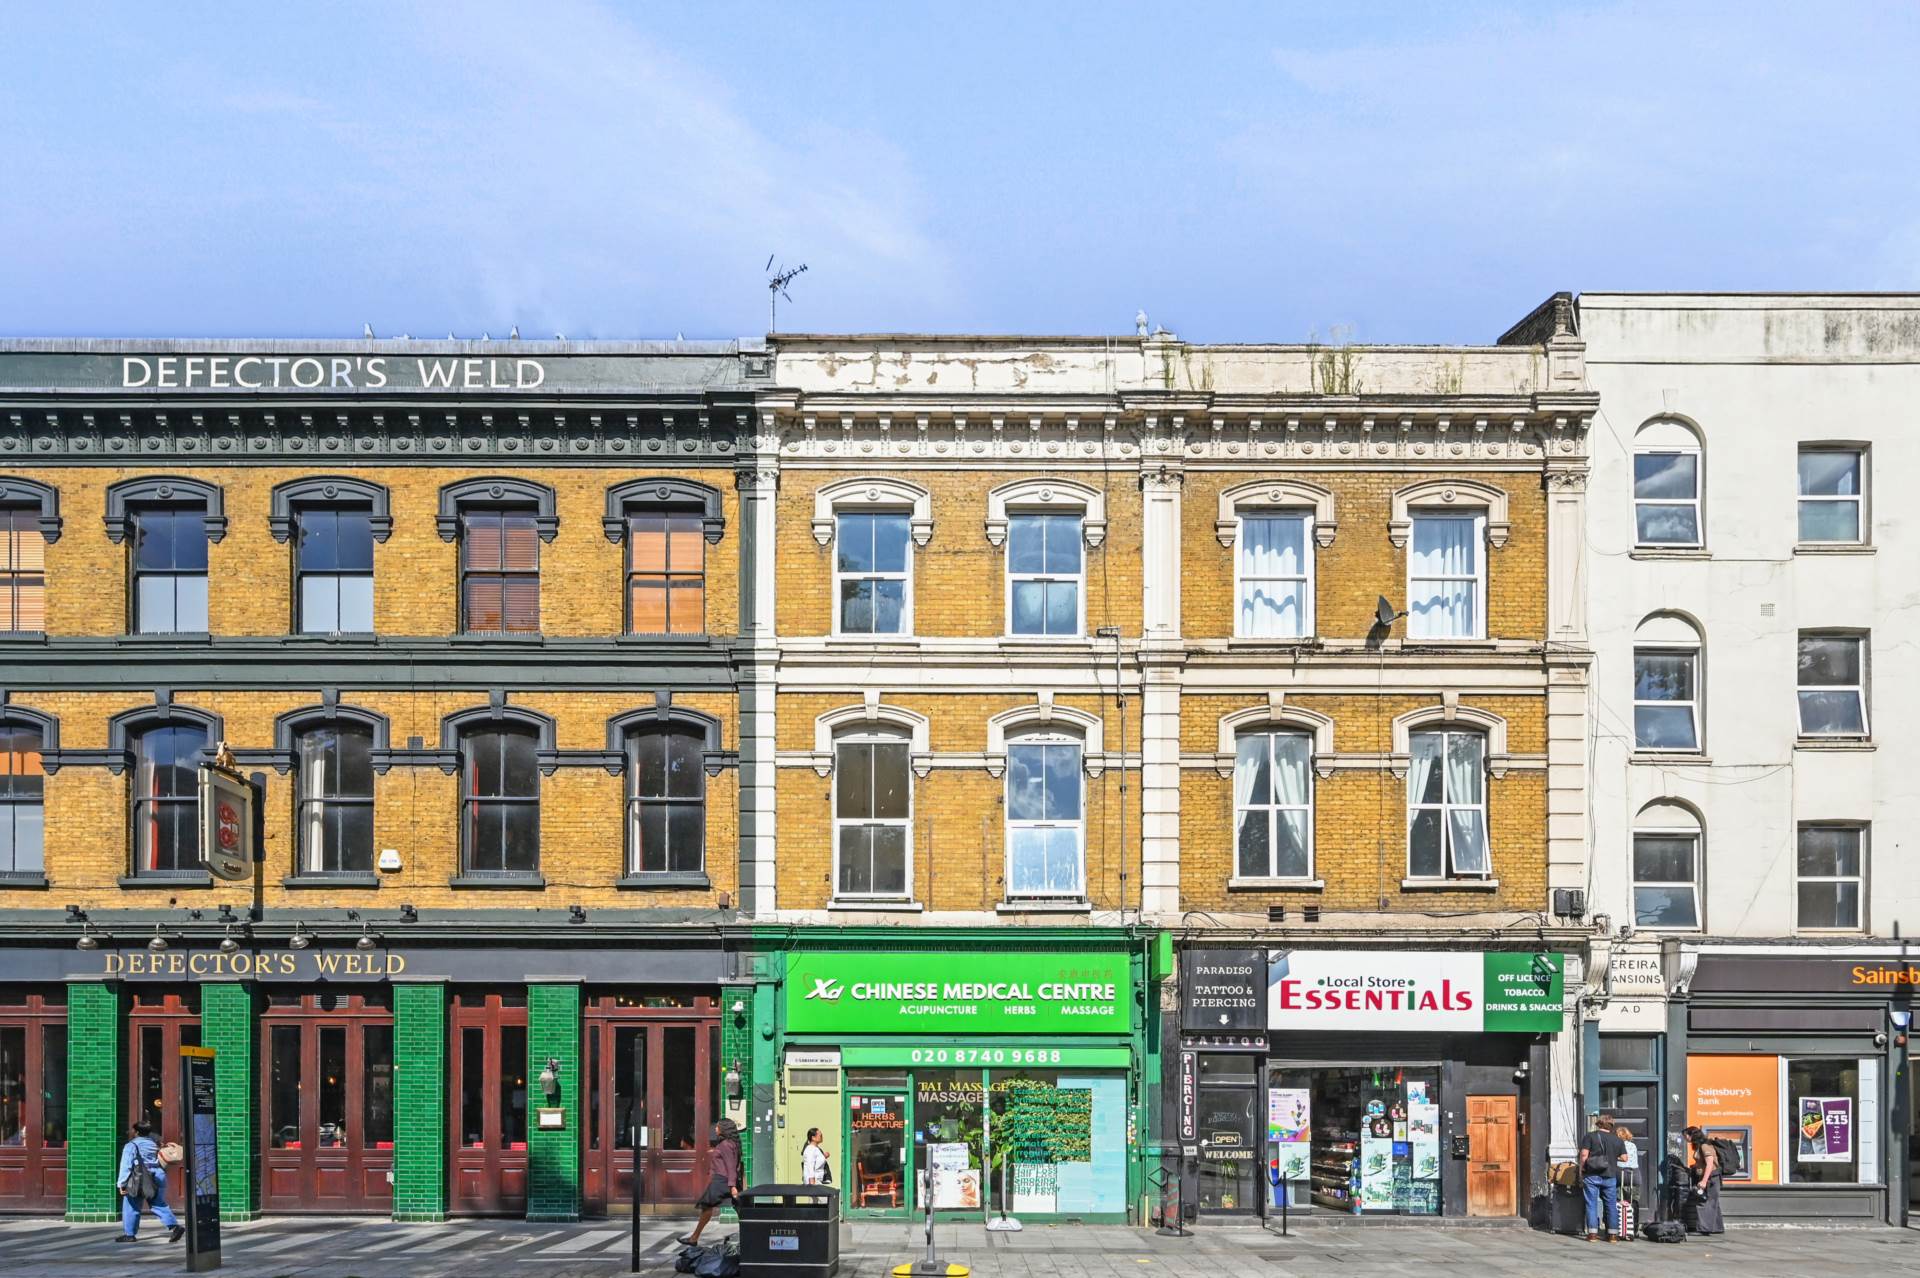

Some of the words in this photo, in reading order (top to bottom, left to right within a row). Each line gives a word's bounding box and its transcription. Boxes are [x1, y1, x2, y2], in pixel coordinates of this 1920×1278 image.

[122, 356, 387, 388] DEFECTOR'S
[417, 357, 546, 389] WELD
[104, 953, 296, 974] DEFECTOR'S
[314, 954, 405, 974] WELD
[1196, 966, 1253, 975] PARADISO
[1852, 966, 1920, 984] Sainsb
[1327, 976, 1363, 988] Local
[1368, 976, 1406, 988] Store
[1498, 974, 1514, 982] OFF
[1516, 974, 1552, 982] LICENCE
[851, 983, 938, 1000] CHINESE
[943, 983, 1033, 1000] MEDICAL
[1038, 983, 1115, 1000] CENTRE
[1195, 985, 1244, 995] TATTOO
[1246, 986, 1253, 995] &
[1504, 988, 1546, 997] TOBACCO
[1192, 998, 1256, 1007] PIERCING
[1486, 1003, 1518, 1011] DRINKS
[1520, 1003, 1527, 1011] &
[1529, 1003, 1562, 1011] SNACKS
[899, 1005, 977, 1015] ACUPUNCTURE
[1004, 1005, 1036, 1015] HERBS
[1061, 1005, 1115, 1015] MASSAGE
[1184, 1036, 1264, 1046] TATTOO
[911, 1050, 948, 1062] 020
[955, 1050, 1004, 1062] 8740
[1012, 1050, 1061, 1062] 9688
[918, 1091, 983, 1103] MASSAGE
[1183, 1054, 1193, 1136] PIERCING
[1697, 1088, 1752, 1098] Sainsbury's
[1697, 1097, 1720, 1105] Bank
[1826, 1114, 1848, 1125] £15
[1205, 1150, 1254, 1159] WELCOME
